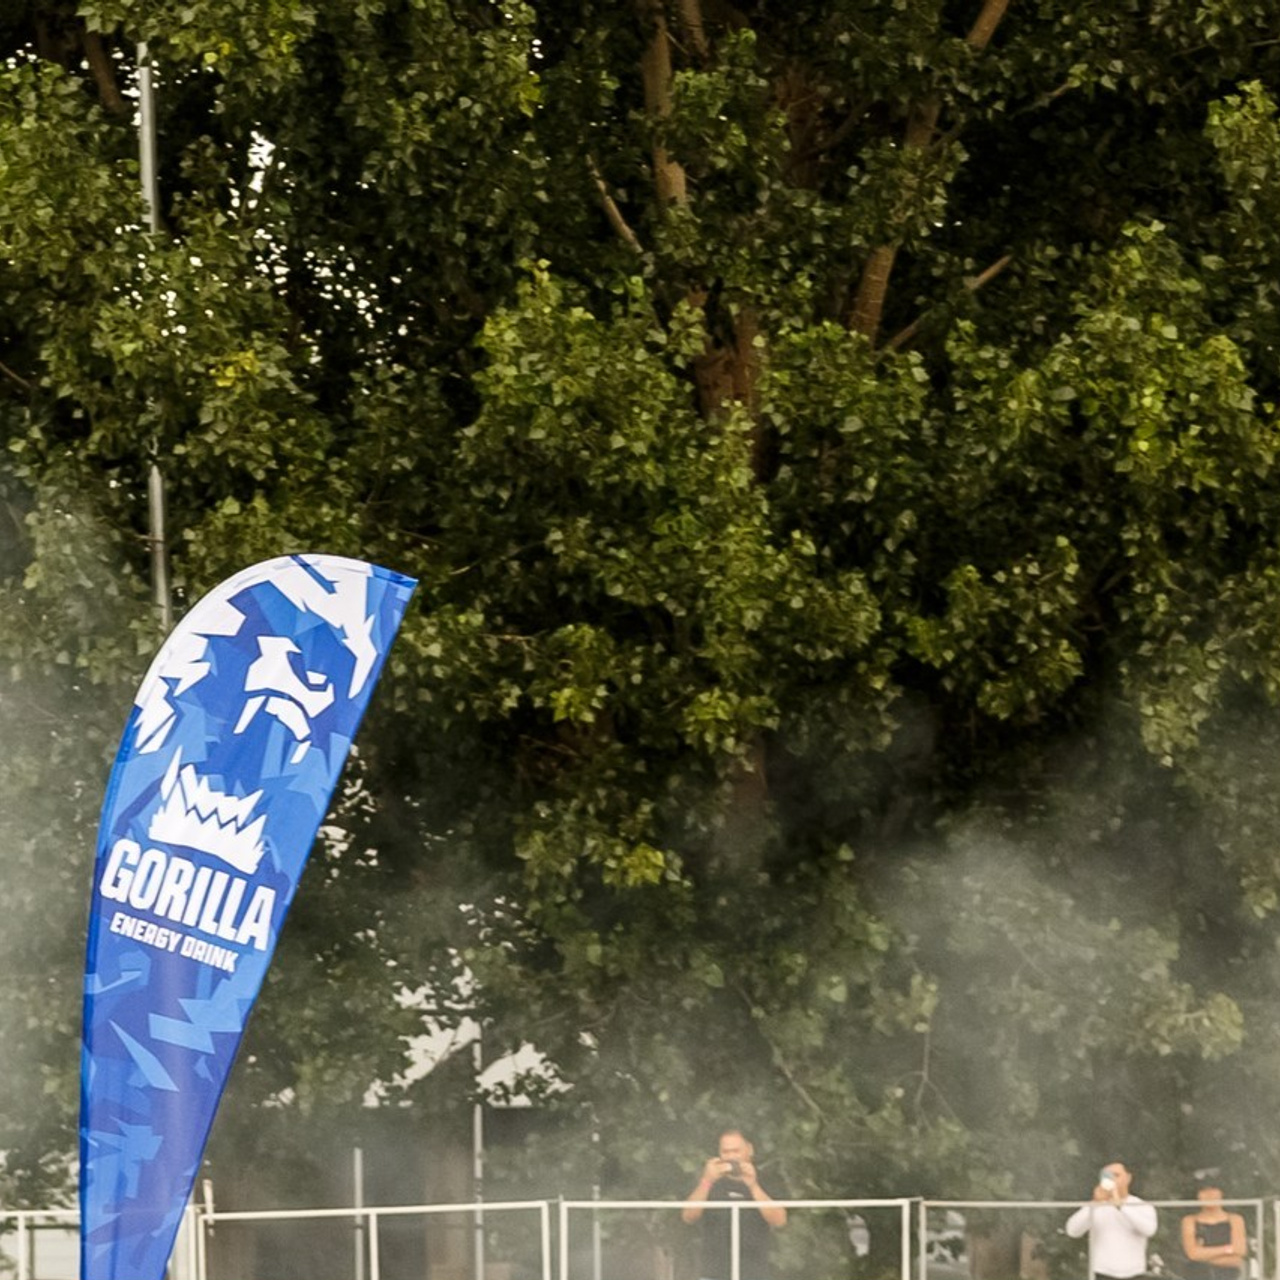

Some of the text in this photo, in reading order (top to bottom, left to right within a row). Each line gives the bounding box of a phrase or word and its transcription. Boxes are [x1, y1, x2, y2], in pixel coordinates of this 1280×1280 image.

[100, 838, 276, 951] GORILLA
[109, 912, 239, 973] ENERGY DRINK
